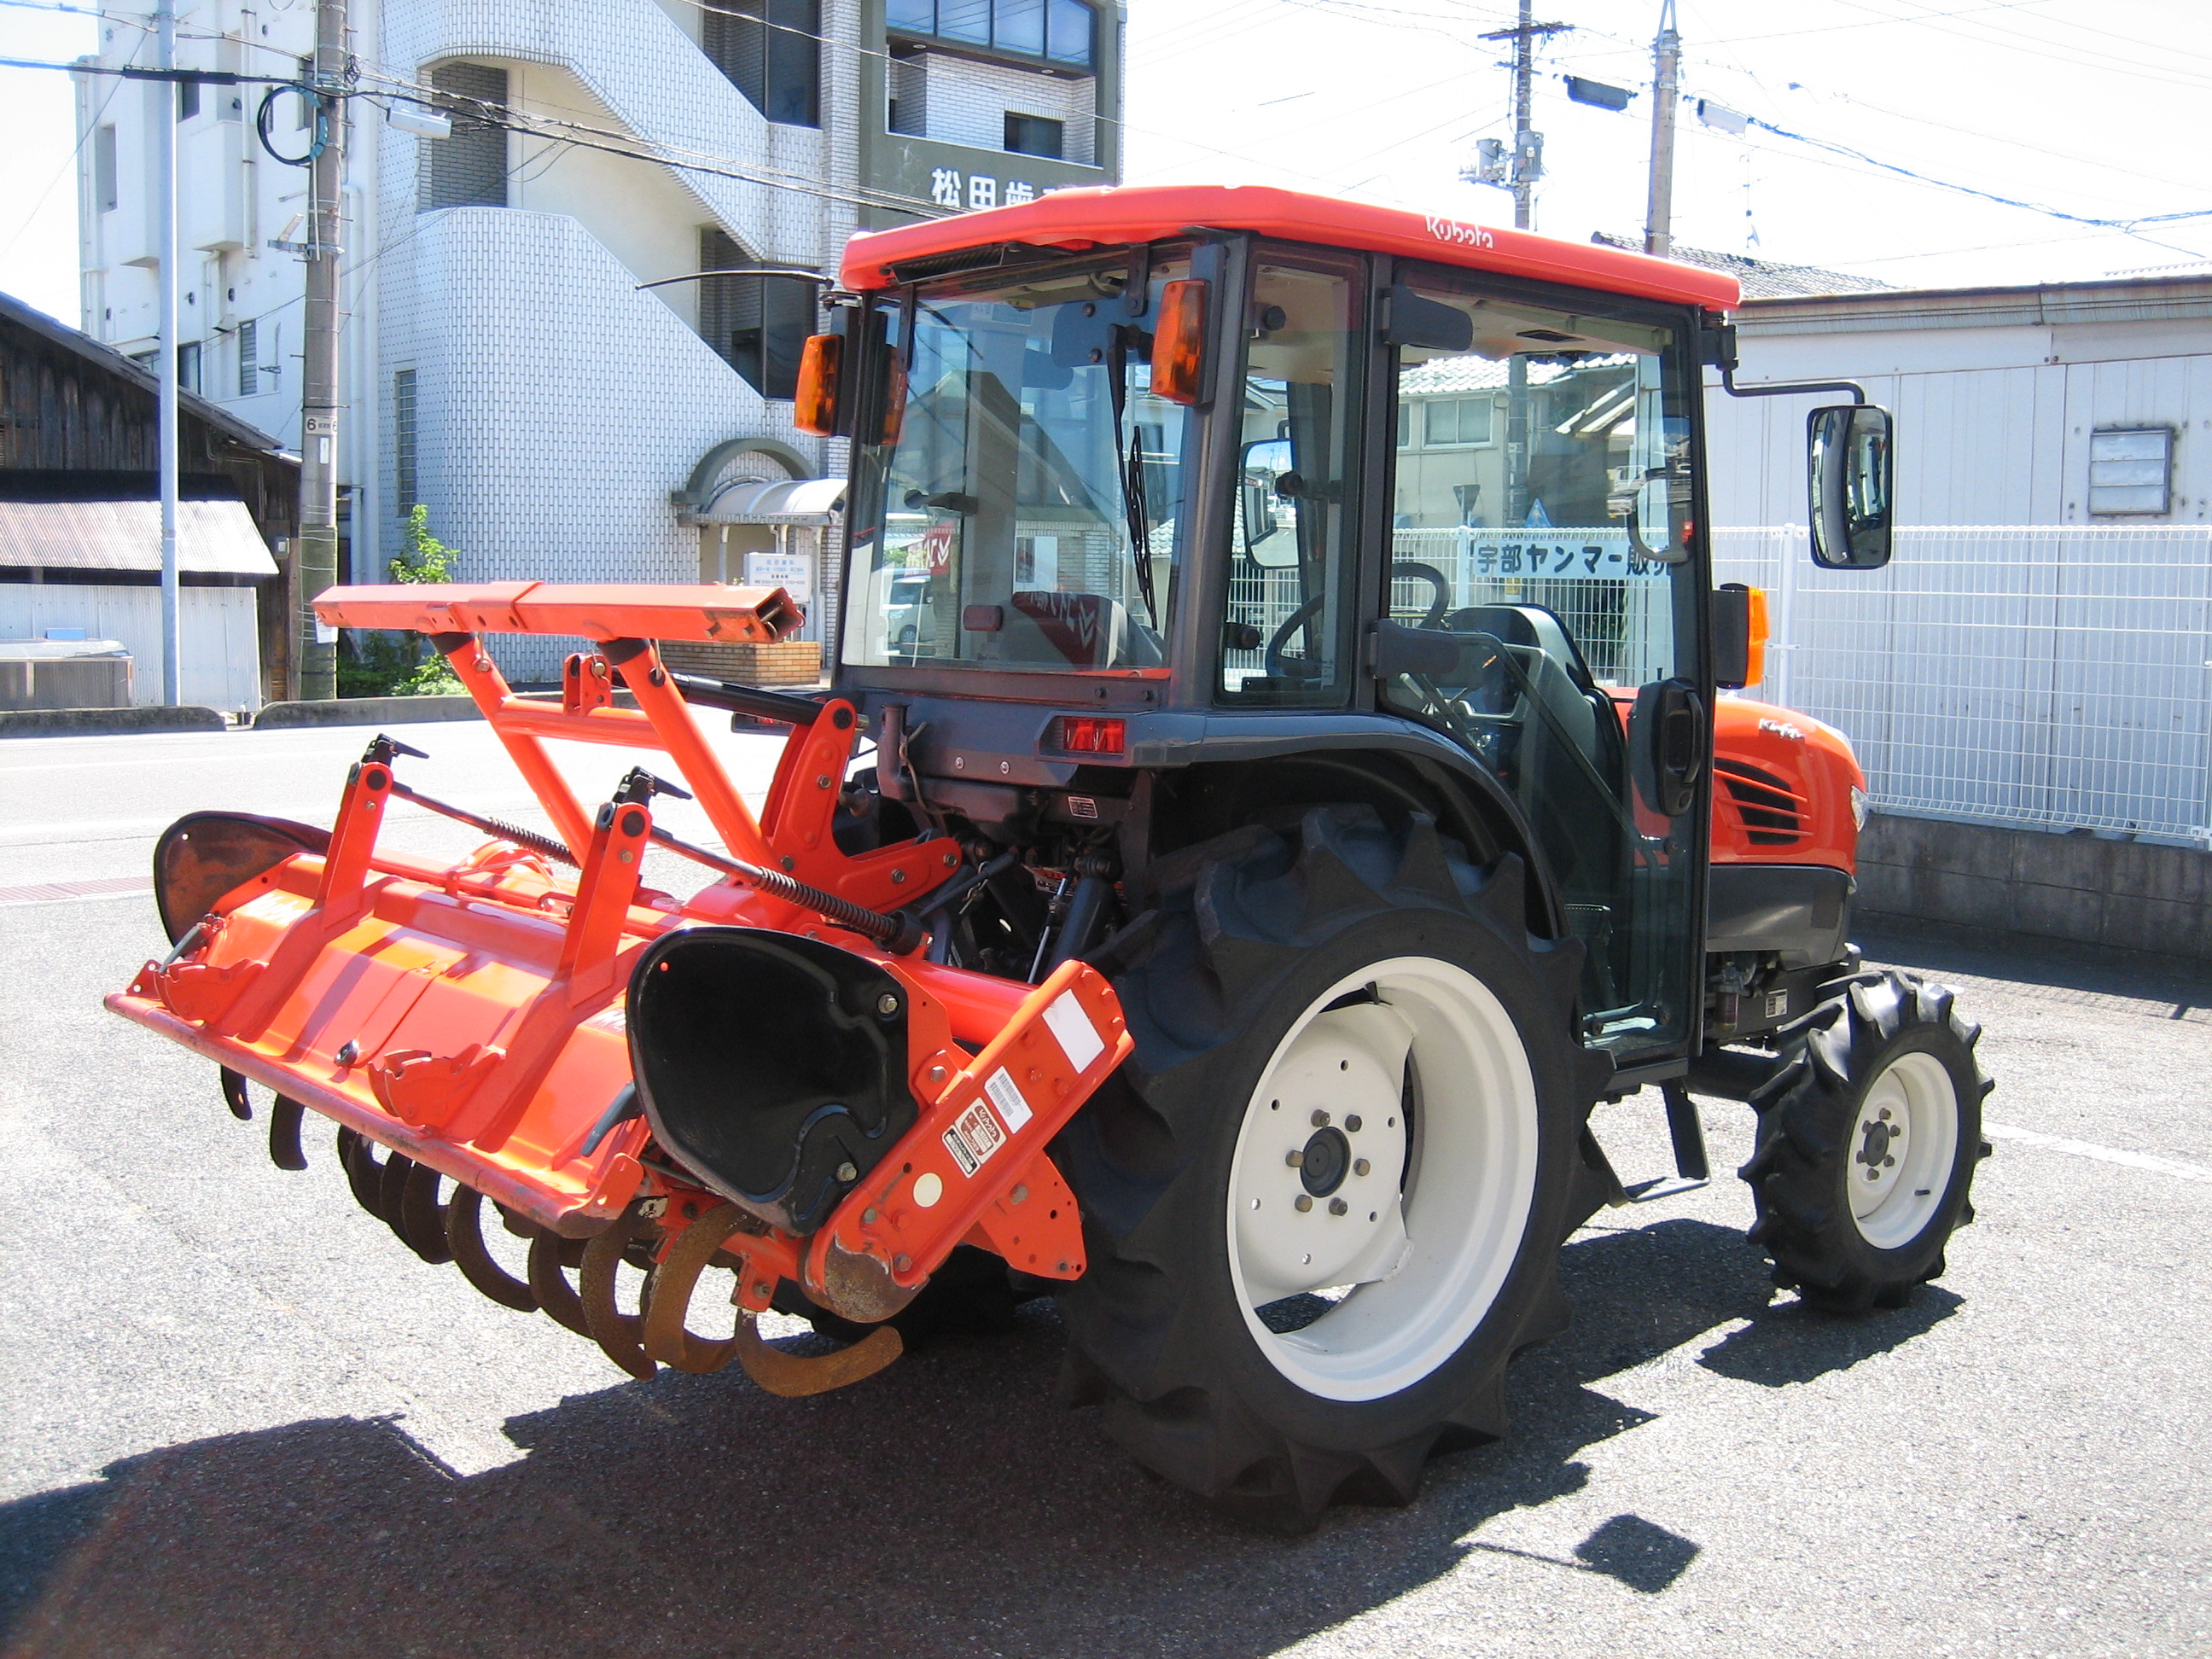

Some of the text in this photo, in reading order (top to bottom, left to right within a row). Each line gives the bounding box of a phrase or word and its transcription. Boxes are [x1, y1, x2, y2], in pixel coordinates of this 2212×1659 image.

[931, 167, 1056, 209] 松田歯
[1425, 216, 1493, 249] Kubota
[307, 418, 317, 431] 6
